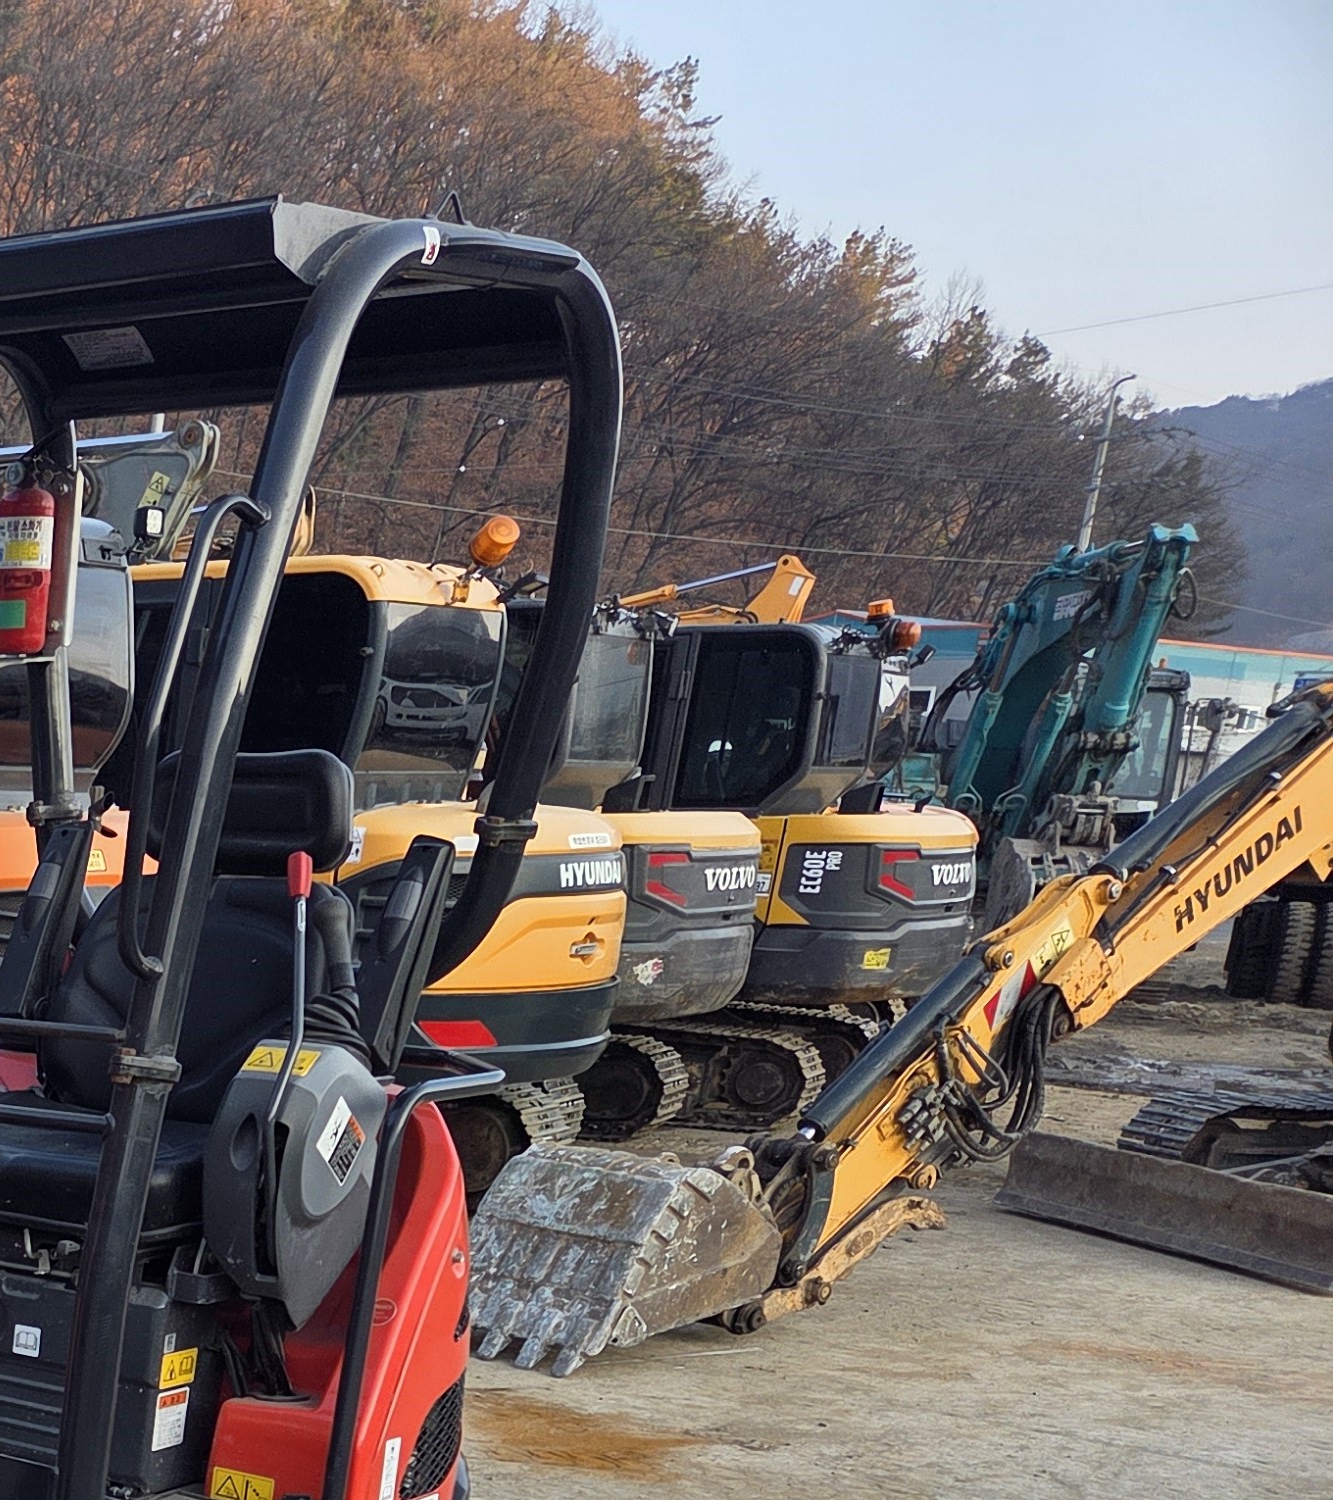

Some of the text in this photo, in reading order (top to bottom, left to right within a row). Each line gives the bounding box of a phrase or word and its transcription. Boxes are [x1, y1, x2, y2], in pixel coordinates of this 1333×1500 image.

[559, 860, 622, 888] HYUNDAI
[798, 850, 827, 894] EC60E
[824, 850, 844, 871] PRO
[1173, 804, 1303, 934] HYUNDAI
[704, 864, 756, 891] VOLVO
